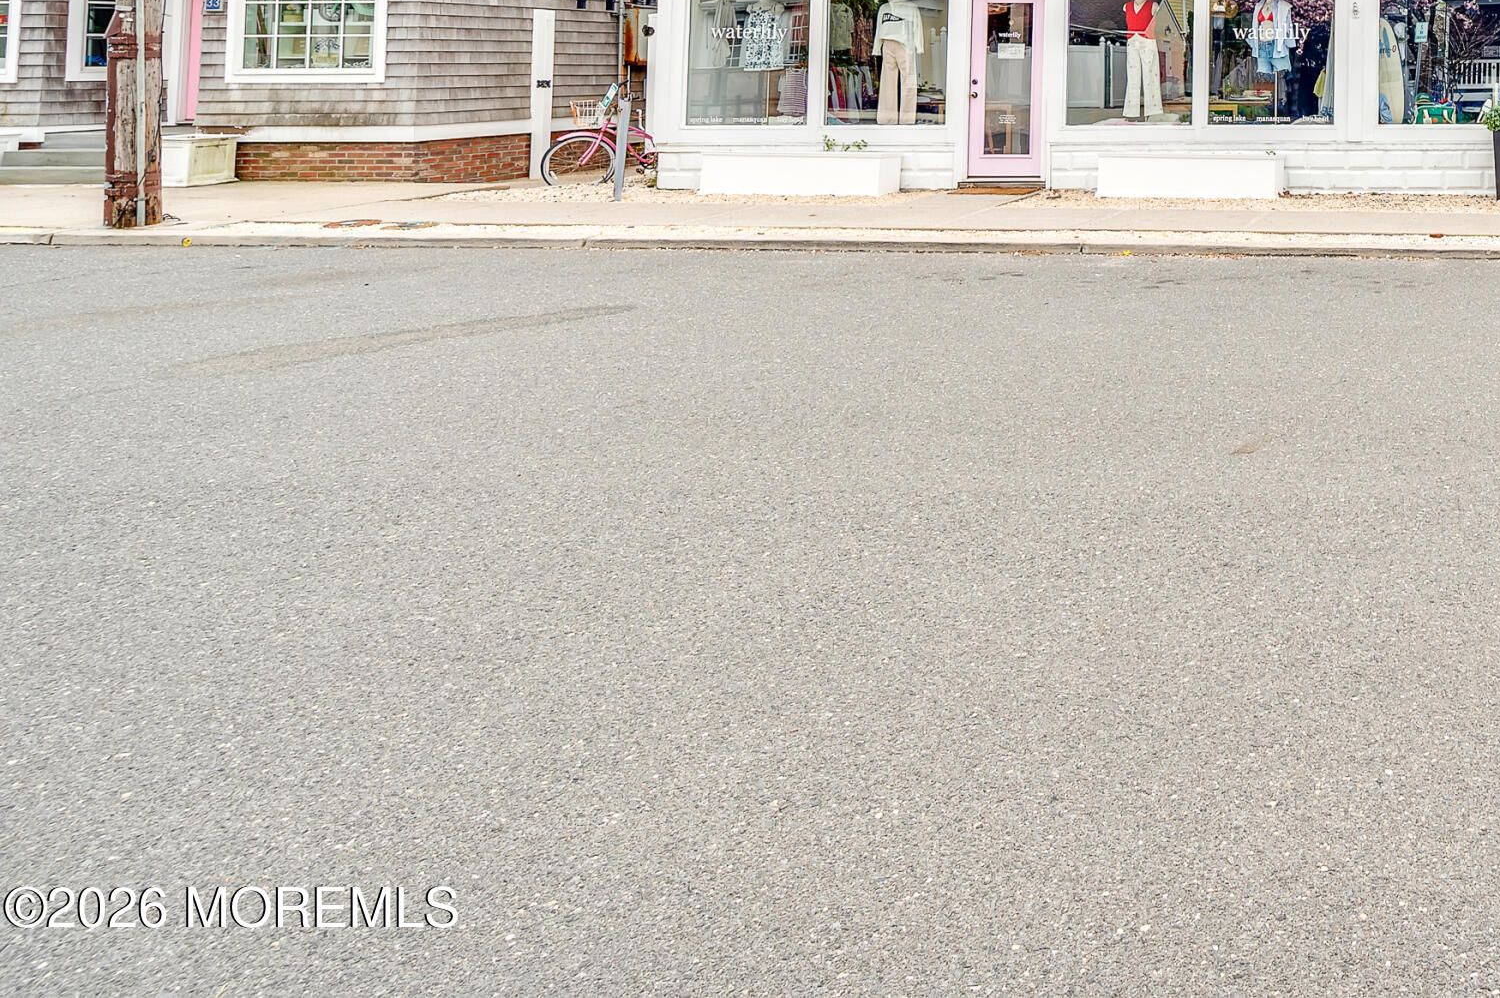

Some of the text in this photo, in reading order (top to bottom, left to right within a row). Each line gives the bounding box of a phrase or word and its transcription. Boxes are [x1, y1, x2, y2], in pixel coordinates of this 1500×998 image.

[711, 23, 788, 43] waterlily
[998, 31, 1021, 39] waterlily
[1233, 22, 1311, 43] waterlily
[1213, 114, 1247, 123] spring lake
[1256, 115, 1291, 123] manasquan
